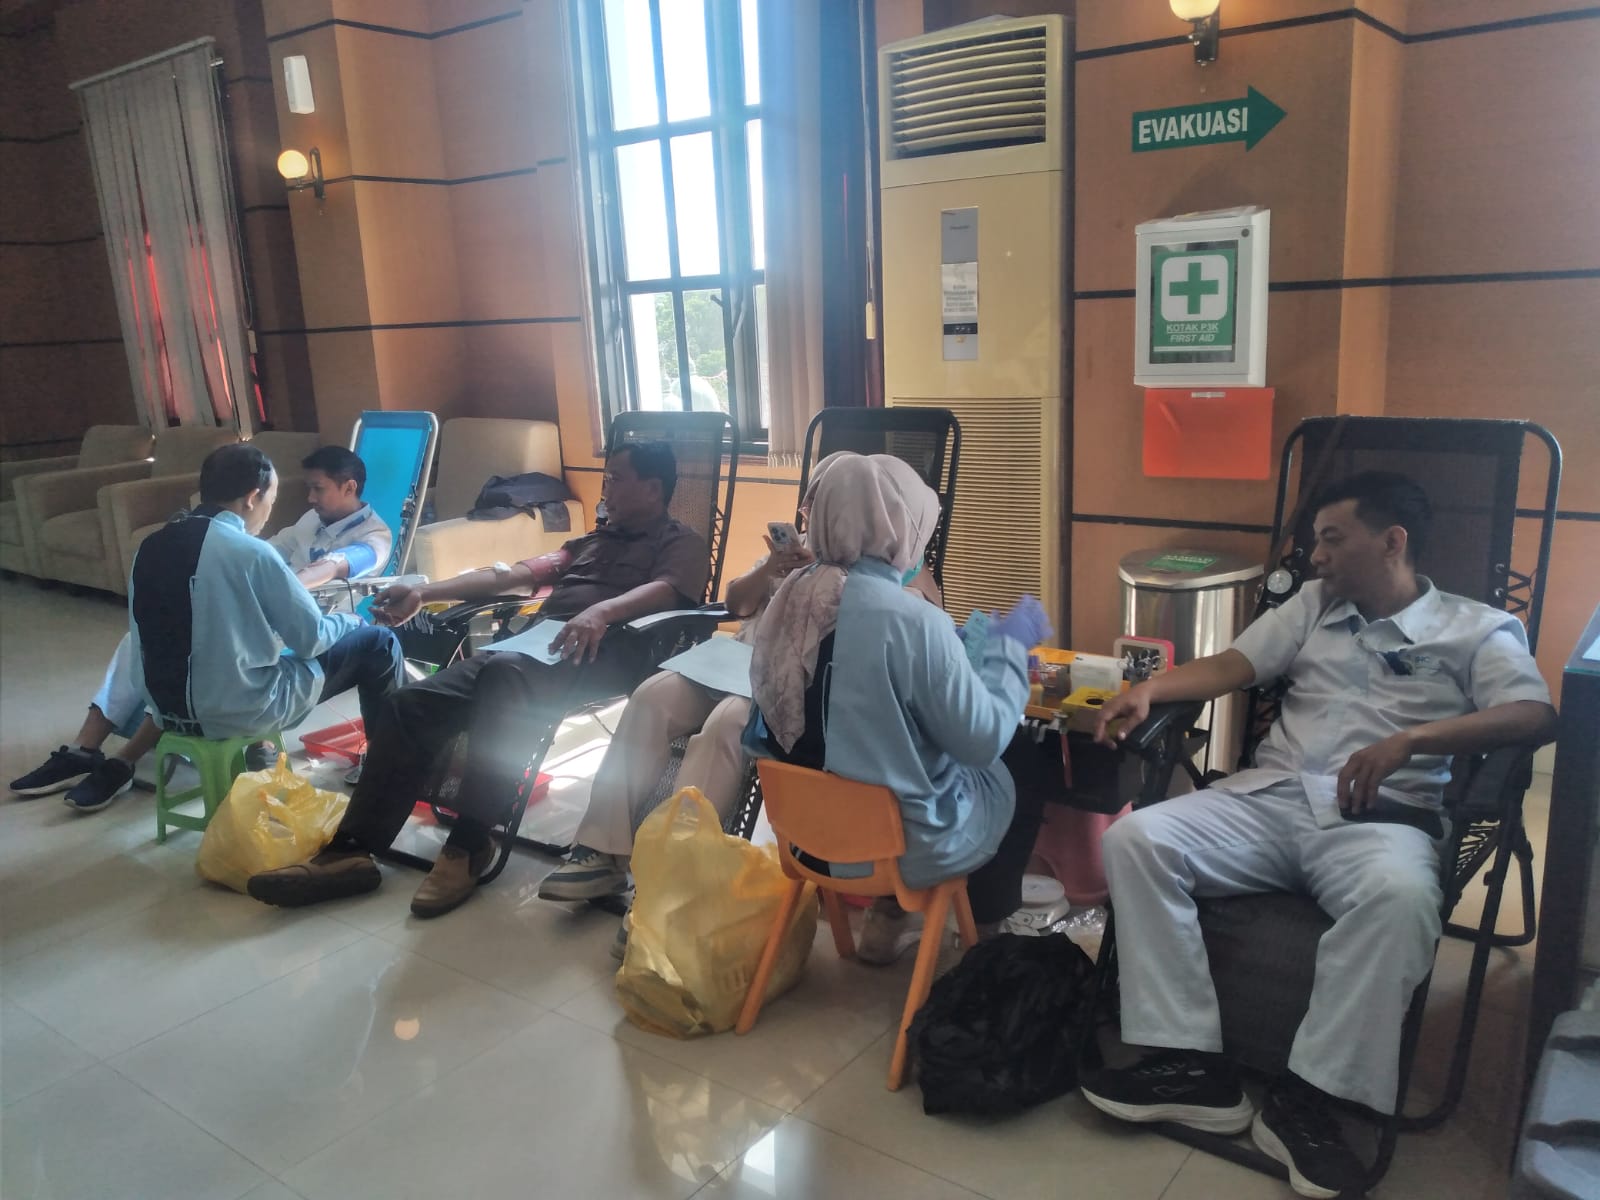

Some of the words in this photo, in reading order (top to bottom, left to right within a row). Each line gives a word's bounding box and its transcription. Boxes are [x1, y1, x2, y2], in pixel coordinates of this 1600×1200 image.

[1138, 107, 1249, 144] EVAKUASI
[1166, 323, 1199, 333] KOTAK
[1200, 322, 1219, 332] P3K
[1169, 334, 1197, 343] FIRST
[1198, 333, 1216, 342] AID
